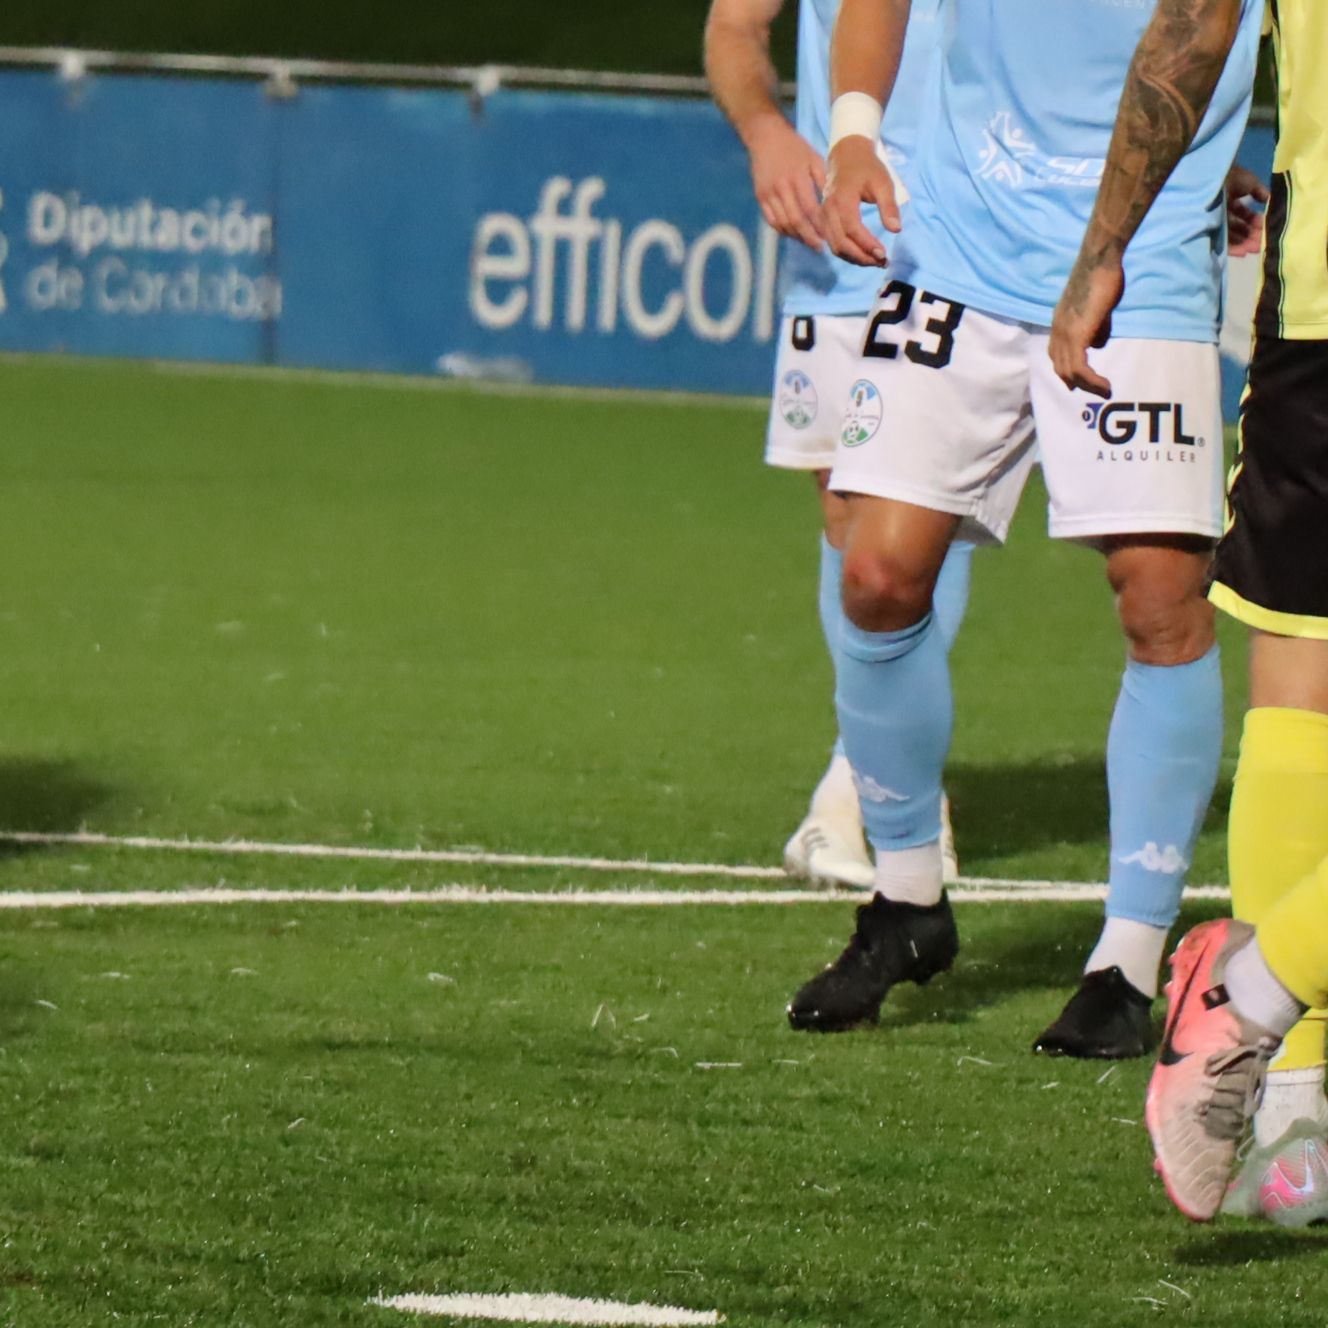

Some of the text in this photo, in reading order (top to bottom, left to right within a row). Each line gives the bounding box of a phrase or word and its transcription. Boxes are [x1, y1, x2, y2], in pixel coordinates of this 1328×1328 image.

[27, 189, 272, 256] Diputación
[862, 279, 966, 369] 23
[1098, 402, 1196, 445] GTL
[1097, 450, 1196, 462] ALQUILER
